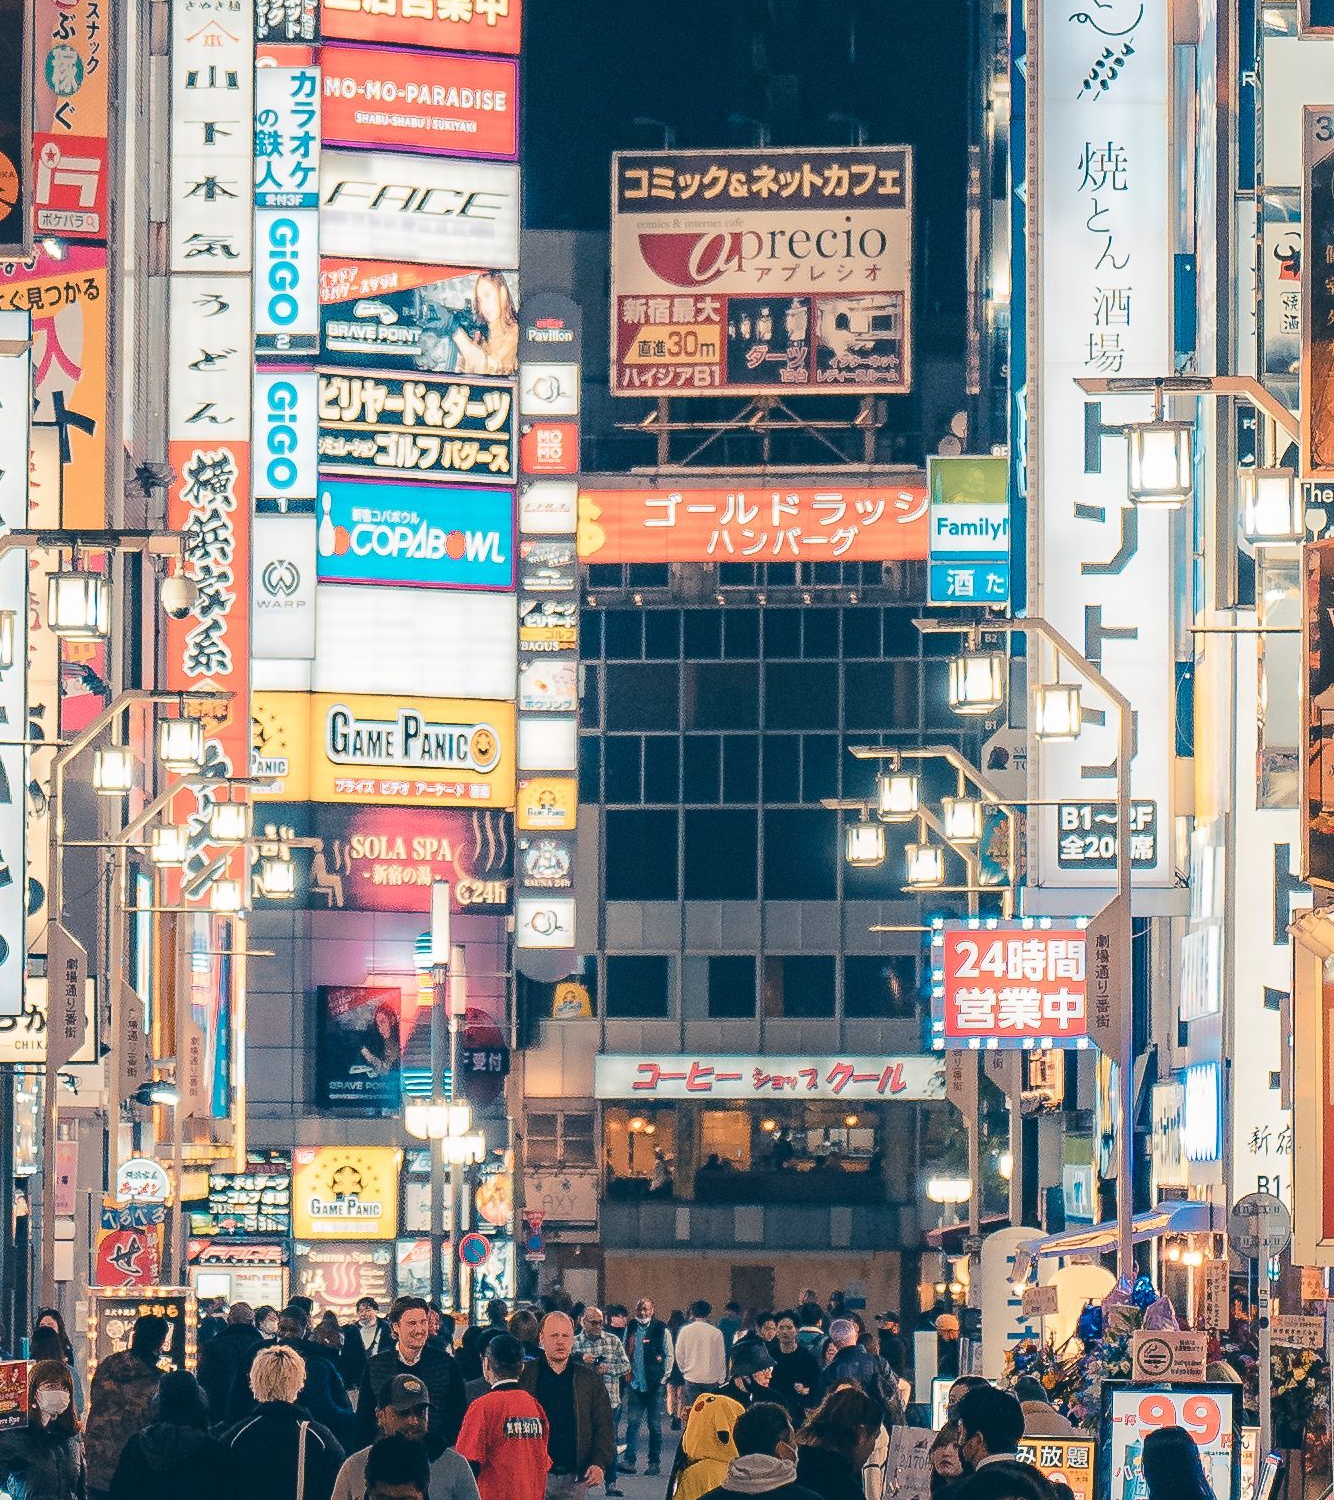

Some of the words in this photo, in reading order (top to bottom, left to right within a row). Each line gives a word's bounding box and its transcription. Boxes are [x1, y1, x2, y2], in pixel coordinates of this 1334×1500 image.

[324, 76, 508, 111] MO-MO-PARADISE
[290, 71, 317, 188] カラオケ
[255, 110, 284, 188] の鉄人
[624, 163, 901, 199] コミック&ネットカフェ
[325, 180, 509, 219] FACE
[41, 213, 85, 231] ポケパラ
[688, 216, 887, 282] aprecio
[1078, 141, 1131, 373] 焼とん酒場
[268, 218, 300, 325] GiGO
[755, 264, 882, 282] アプレシオ
[623, 298, 721, 324] 新宿最大
[328, 323, 377, 341] BRAVE
[378, 325, 423, 342] POINT
[747, 346, 808, 369] ダーツ
[622, 366, 721, 388] ハイジアB1
[319, 377, 511, 430] ビリヤード&ダーツ
[267, 382, 298, 489] GiGO
[1303, 485, 1334, 502] The
[706, 527, 859, 557] ハンバーグ
[946, 570, 974, 597] 酒
[256, 600, 307, 609] WARP
[332, 712, 395, 758] GAME
[403, 714, 469, 762] PANIC
[351, 836, 406, 860] SOLA
[412, 837, 453, 862] SPA
[954, 939, 1086, 983] 24時間
[953, 990, 1086, 1031] 営業中
[632, 1062, 743, 1091] コーヒー
[825, 1063, 907, 1094] クール
[312, 1198, 344, 1216] GAME
[347, 1198, 381, 1218] PANIC
